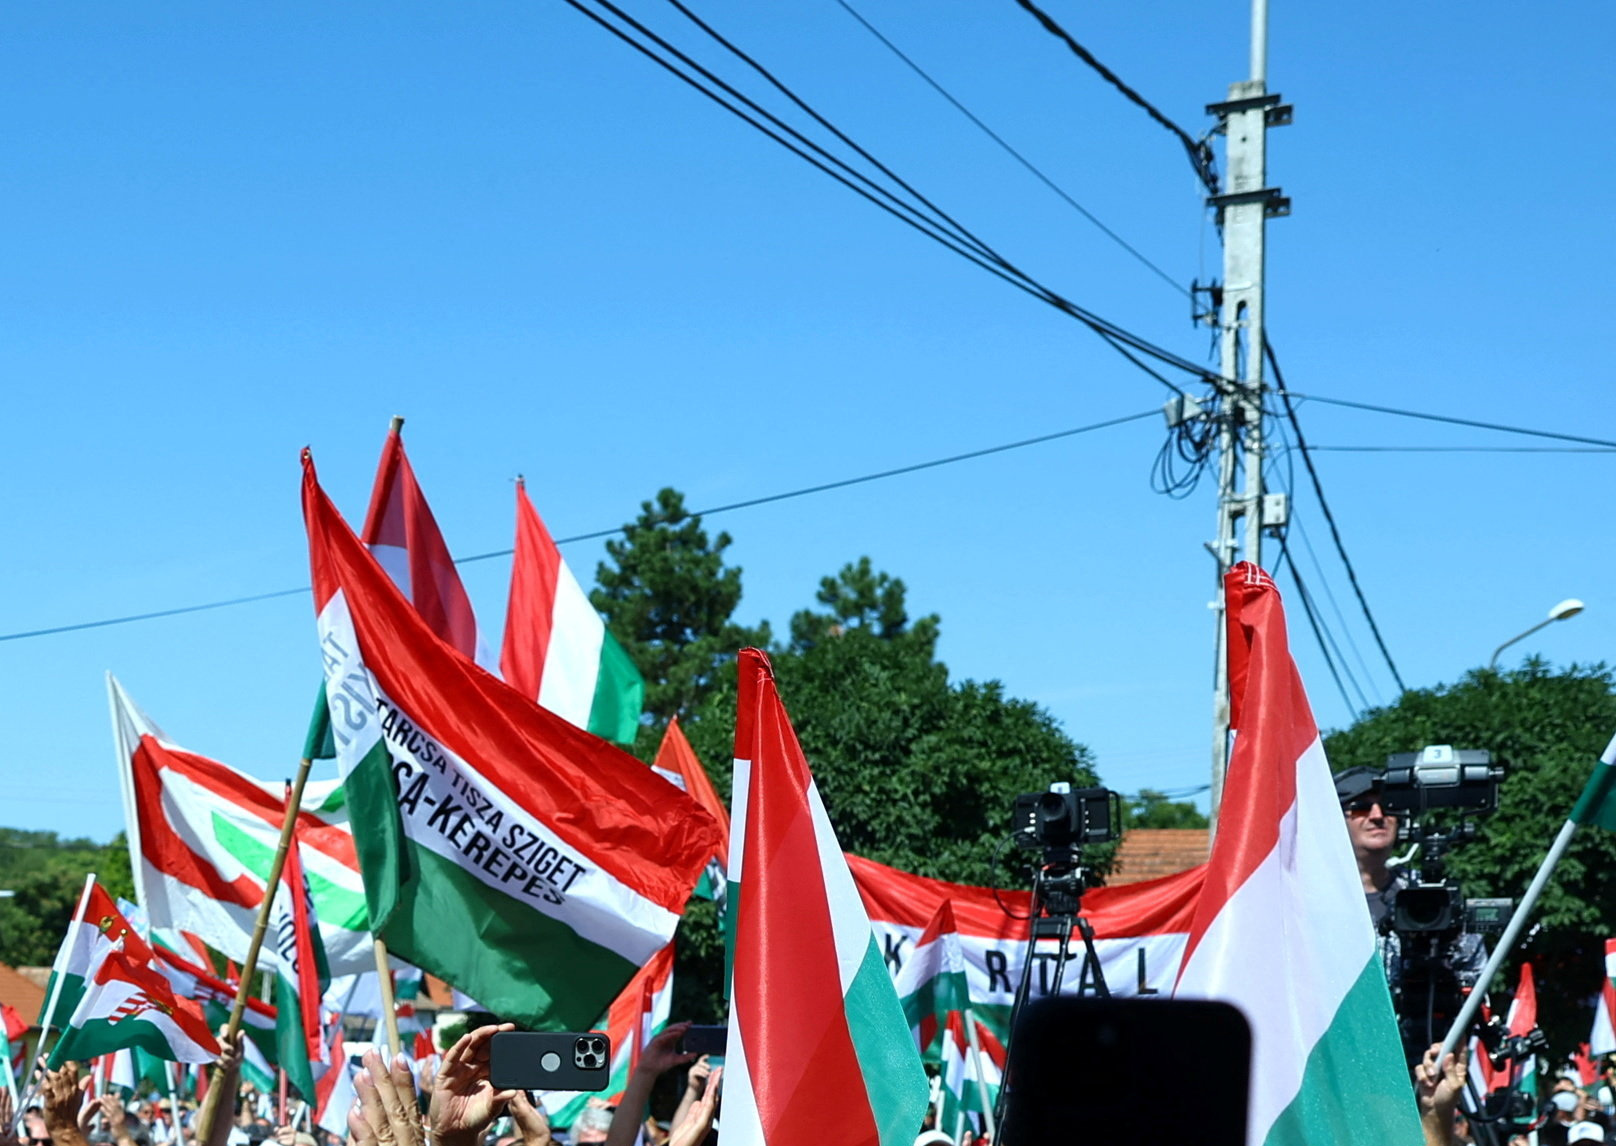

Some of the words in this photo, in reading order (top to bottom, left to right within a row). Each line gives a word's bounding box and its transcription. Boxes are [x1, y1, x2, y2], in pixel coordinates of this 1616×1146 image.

[388, 752, 567, 906] SA-KEREPES
[451, 767, 506, 833] TISZA
[502, 823, 587, 892] SZIGET
[884, 932, 1159, 998] KRTAL
